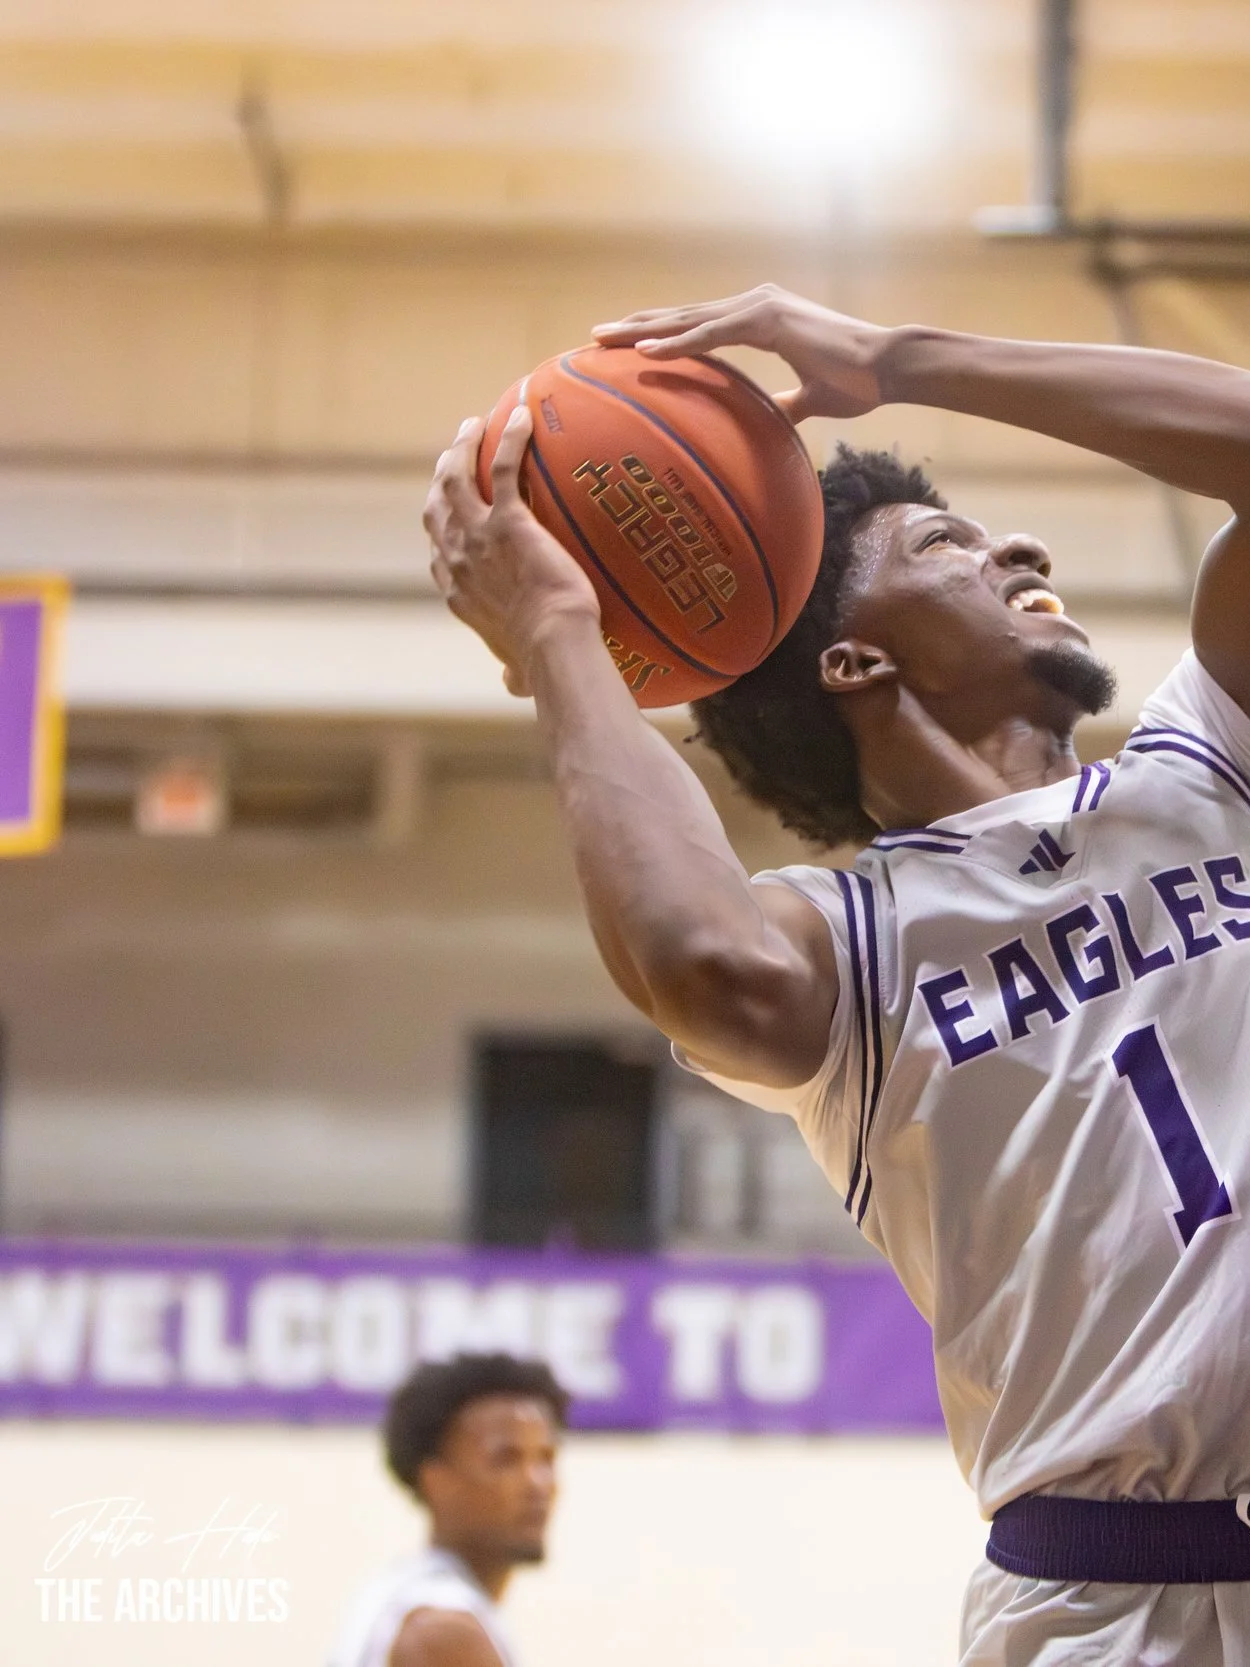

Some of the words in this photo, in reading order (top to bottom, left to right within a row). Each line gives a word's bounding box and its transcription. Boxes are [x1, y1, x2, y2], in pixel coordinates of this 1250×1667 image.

[571, 458, 727, 634] LEGACY
[1108, 1015, 1241, 1254] 1
[0, 1270, 625, 1394] WELCOME
[654, 1284, 825, 1401] TO
